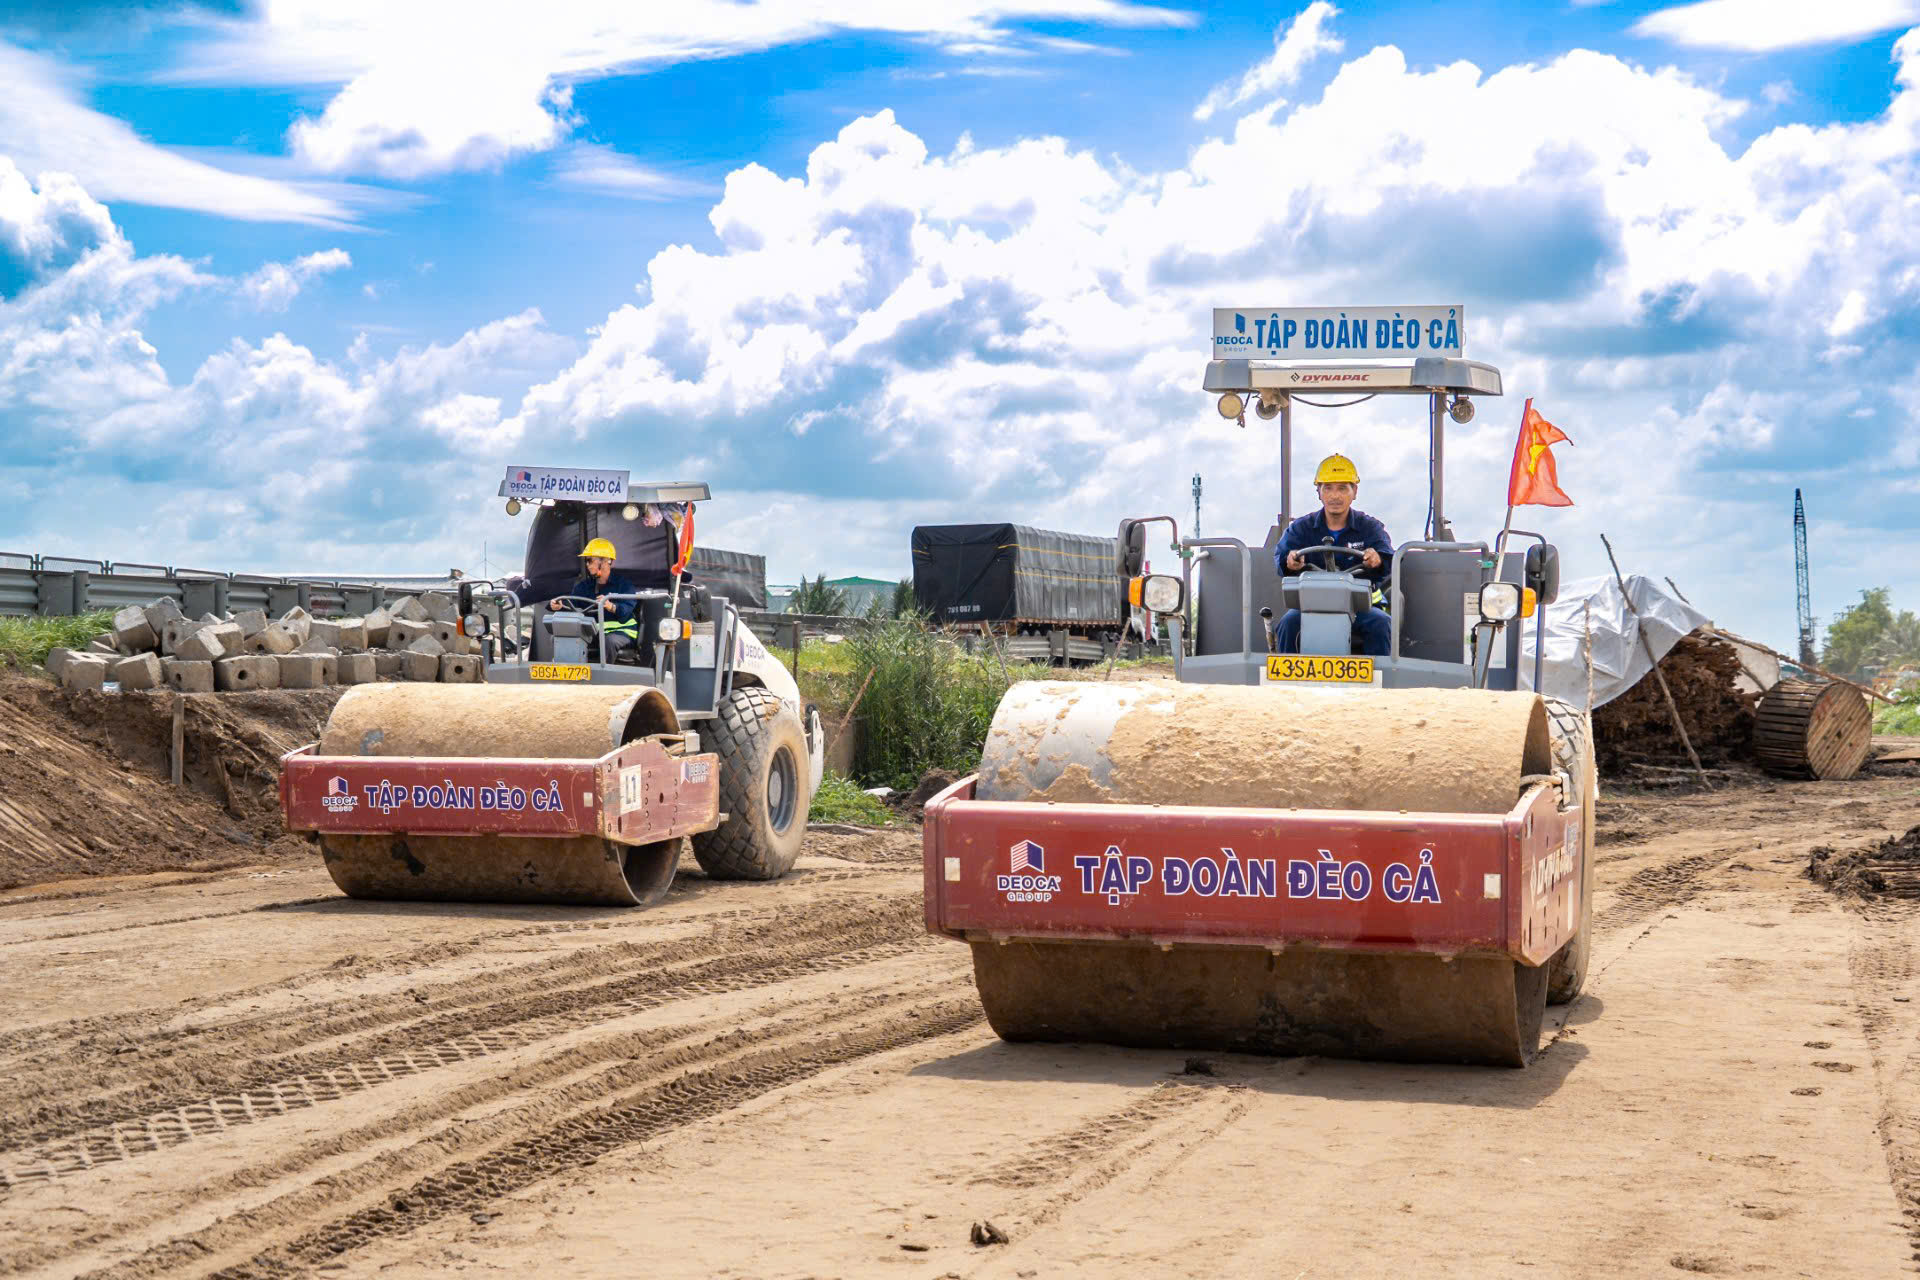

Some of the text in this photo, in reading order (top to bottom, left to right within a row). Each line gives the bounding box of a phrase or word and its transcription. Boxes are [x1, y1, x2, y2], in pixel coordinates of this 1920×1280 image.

[1255, 308, 1459, 355] TẬP ĐOÀN ĐÈO CẢ
[1216, 336, 1253, 345] DEOCA
[1302, 374, 1370, 382] DYNAPAC
[511, 482, 537, 490] DEOCA
[540, 474, 556, 494] TẬP
[559, 475, 585, 493] ĐOÀN
[322, 796, 358, 806] DEOCA
[364, 779, 563, 814] TẬP ĐOÀN ĐÈO CẢ
[1074, 845, 1441, 905] TẬP ĐOÀN ĐÈO CẢ
[997, 875, 1061, 892] DEOCA
[1007, 892, 1052, 902] GROUP
